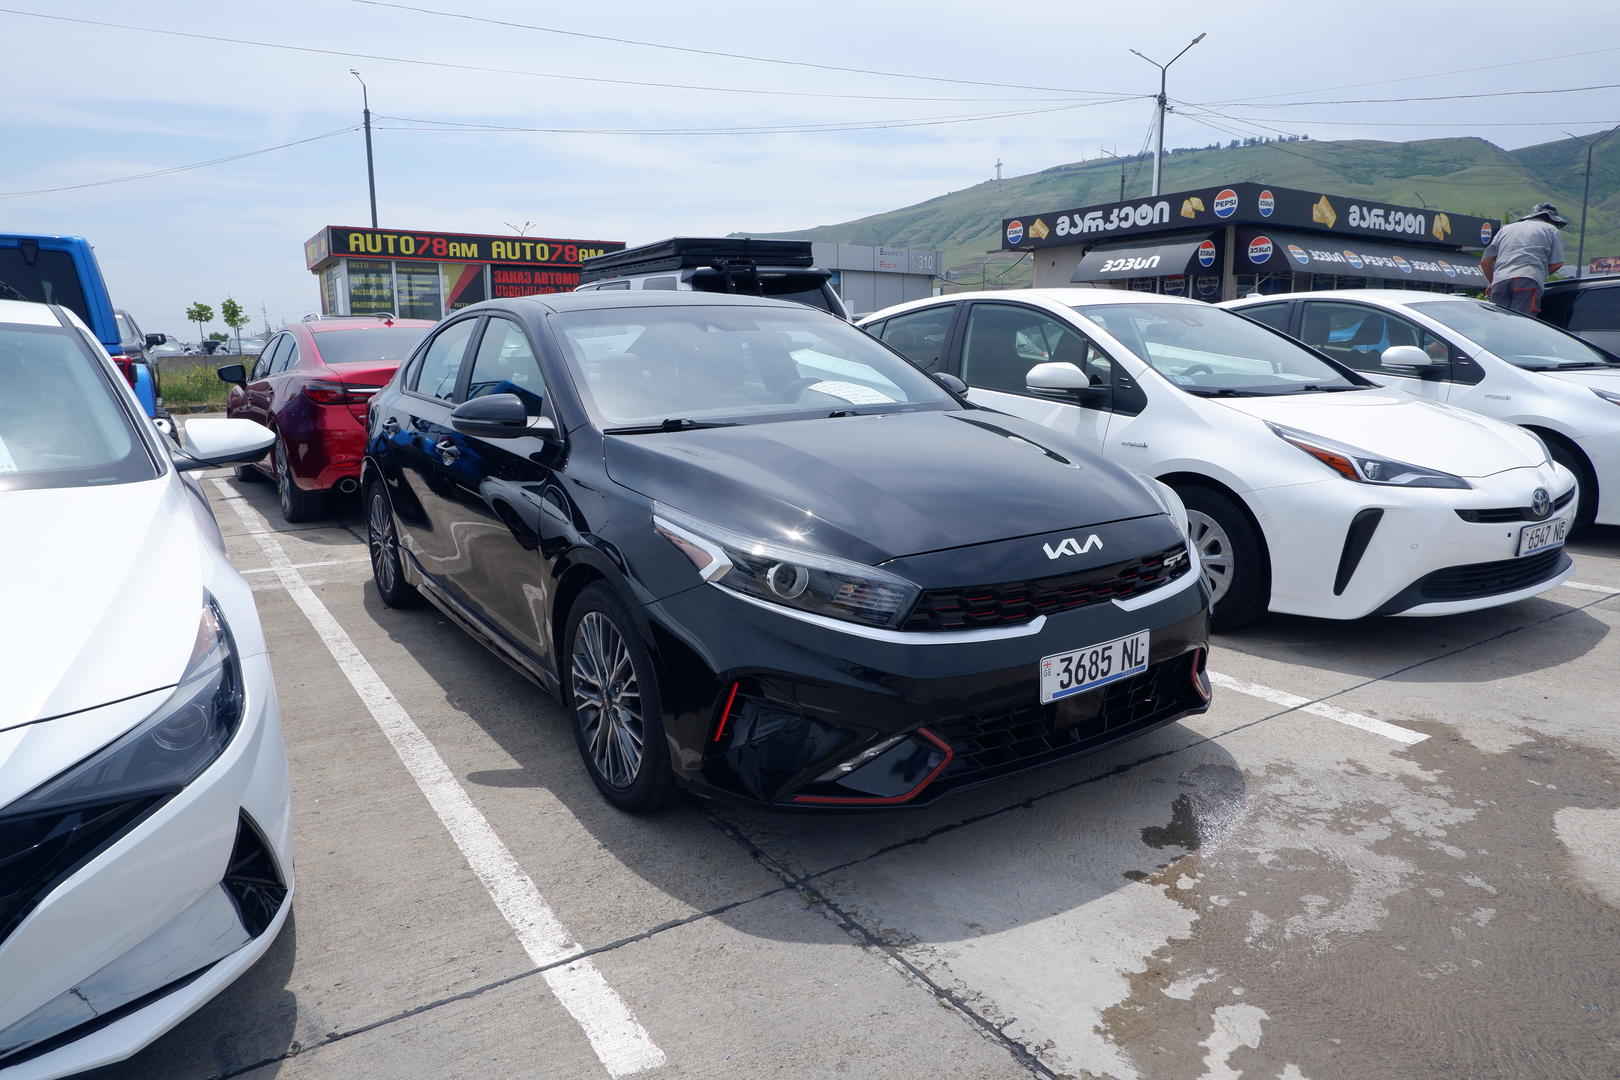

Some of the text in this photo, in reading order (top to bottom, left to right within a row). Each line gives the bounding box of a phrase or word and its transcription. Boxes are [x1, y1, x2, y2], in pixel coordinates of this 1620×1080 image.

[1215, 199, 1237, 208] PEPSI
[1055, 201, 1170, 236] მარკეტი
[1349, 205, 1425, 235] მარკეტი
[349, 232, 478, 258] AUTO78AM
[918, 255, 933, 270] 310
[1100, 255, 1161, 273] პეპსი
[1308, 249, 1345, 263] პეპსი
[1361, 254, 1395, 267] PEPSI
[1452, 264, 1483, 276] PEPSI
[494, 270, 531, 284] ЗАКАЗ
[1043, 534, 1103, 559] KIA
[1528, 526, 1551, 549] 6547
[1059, 637, 1145, 689] 3685 NL
